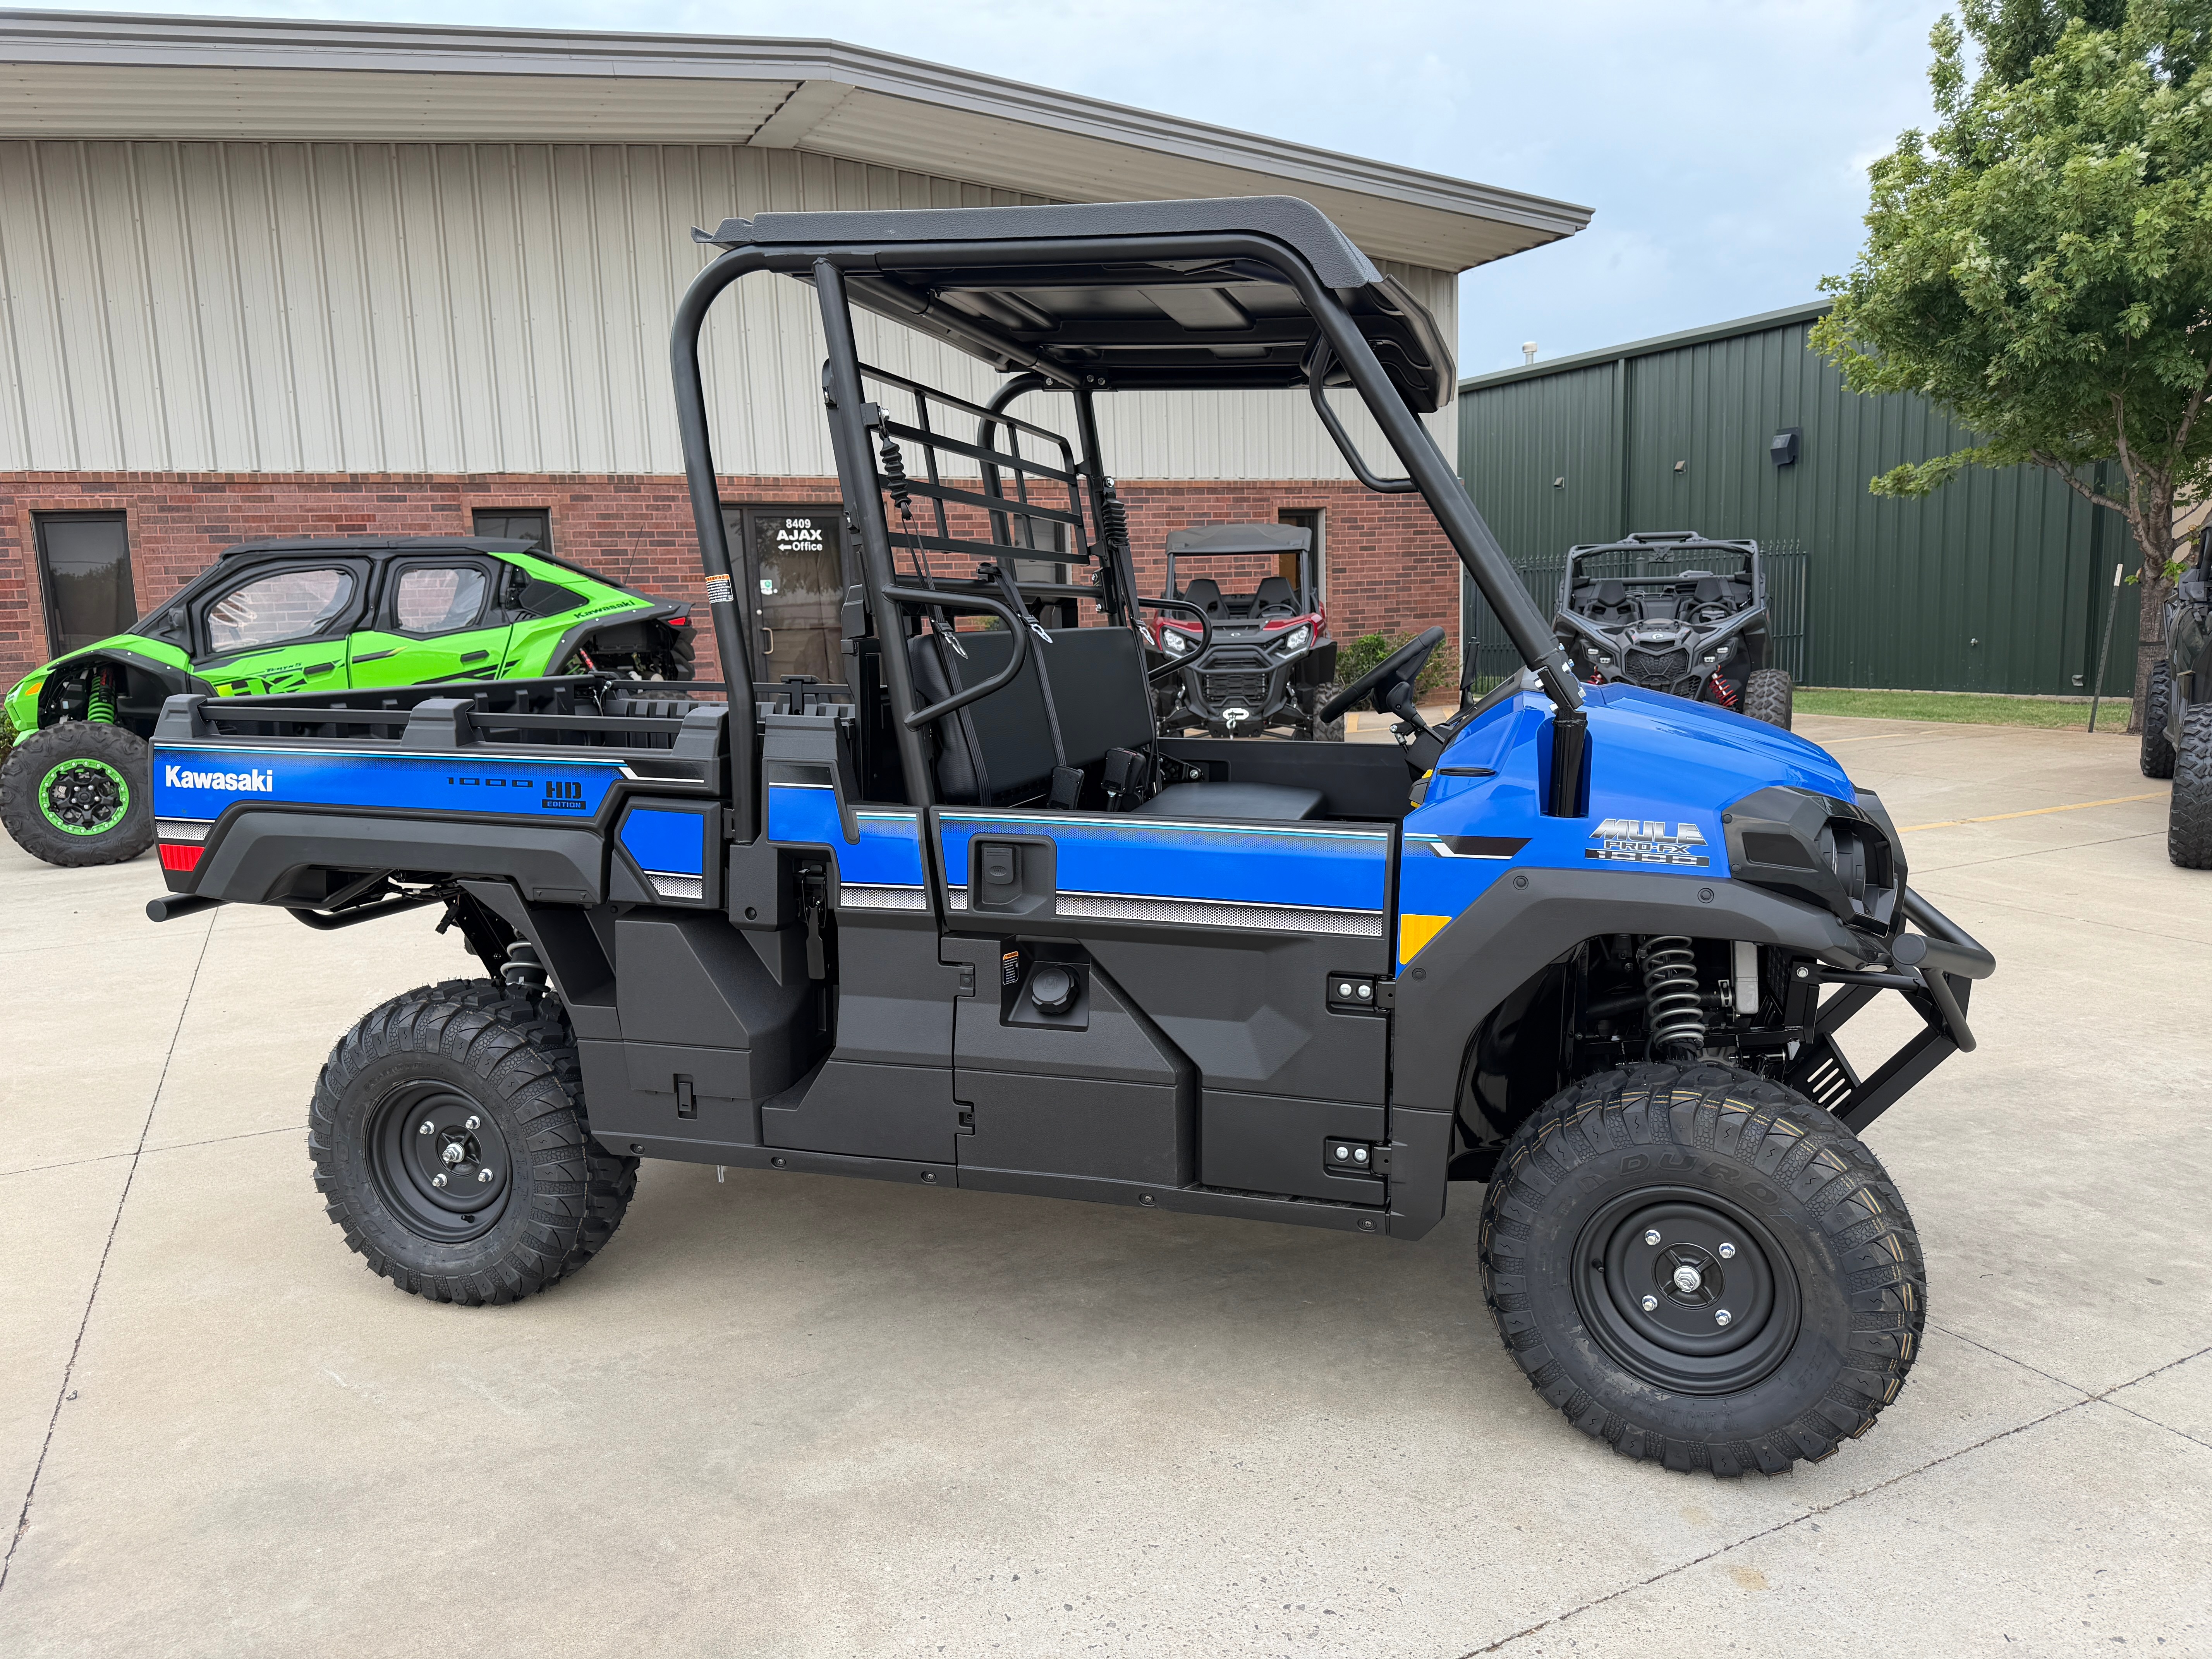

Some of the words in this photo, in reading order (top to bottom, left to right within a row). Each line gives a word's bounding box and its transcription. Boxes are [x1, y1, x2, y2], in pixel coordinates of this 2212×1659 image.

[786, 519, 811, 529] 8409
[776, 529, 823, 541] AJAX
[792, 541, 823, 551] Office
[574, 600, 635, 618] Kawasaki
[165, 765, 273, 792] Kawasaki
[447, 777, 533, 788] 1000
[546, 781, 582, 799] HD
[1589, 818, 1709, 846] MULE
[1604, 840, 1692, 855] PRO-FX
[1597, 850, 1697, 865] 1000
[1620, 1152, 1781, 1206] DURO
